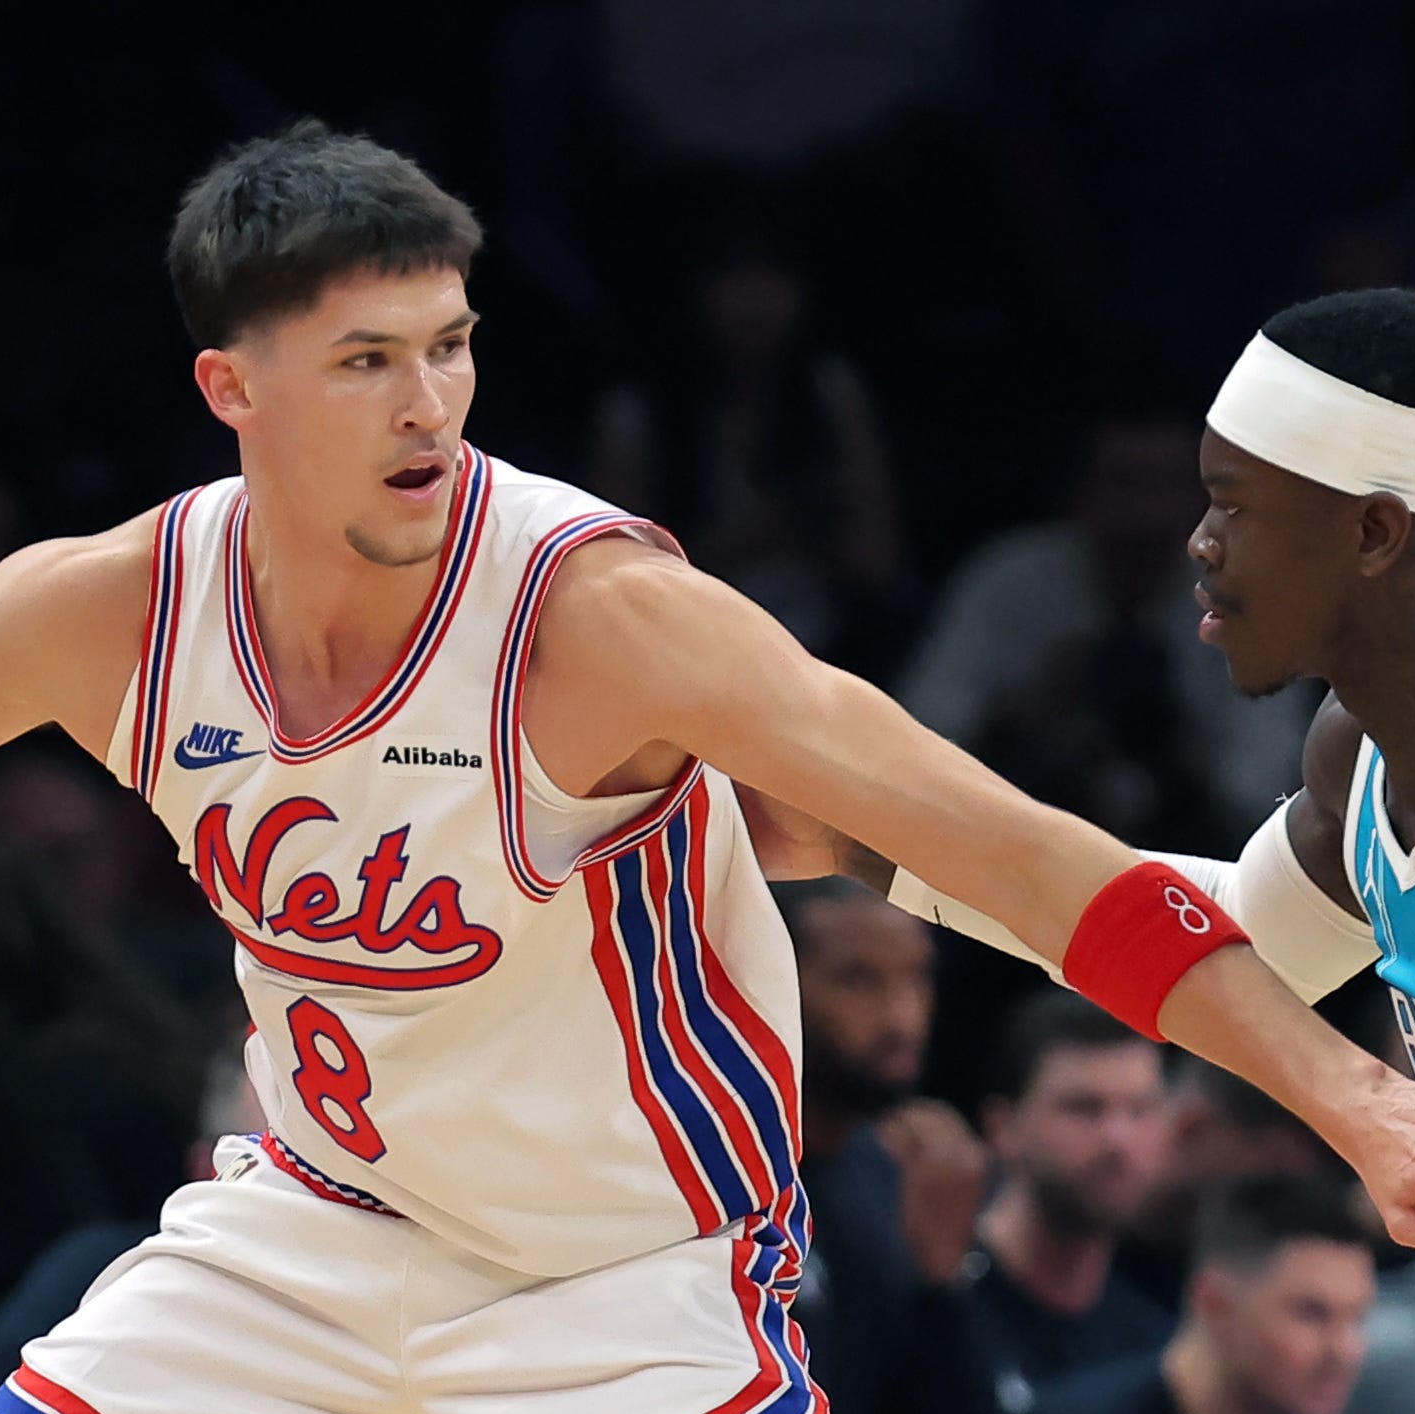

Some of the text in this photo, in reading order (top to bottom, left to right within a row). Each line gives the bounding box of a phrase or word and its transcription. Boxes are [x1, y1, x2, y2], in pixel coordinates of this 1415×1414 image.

[187, 721, 244, 755] NIKE
[382, 745, 483, 769] Alibaba
[194, 795, 503, 978] Nets
[1162, 885, 1211, 934] 8
[286, 994, 387, 1164] 8
